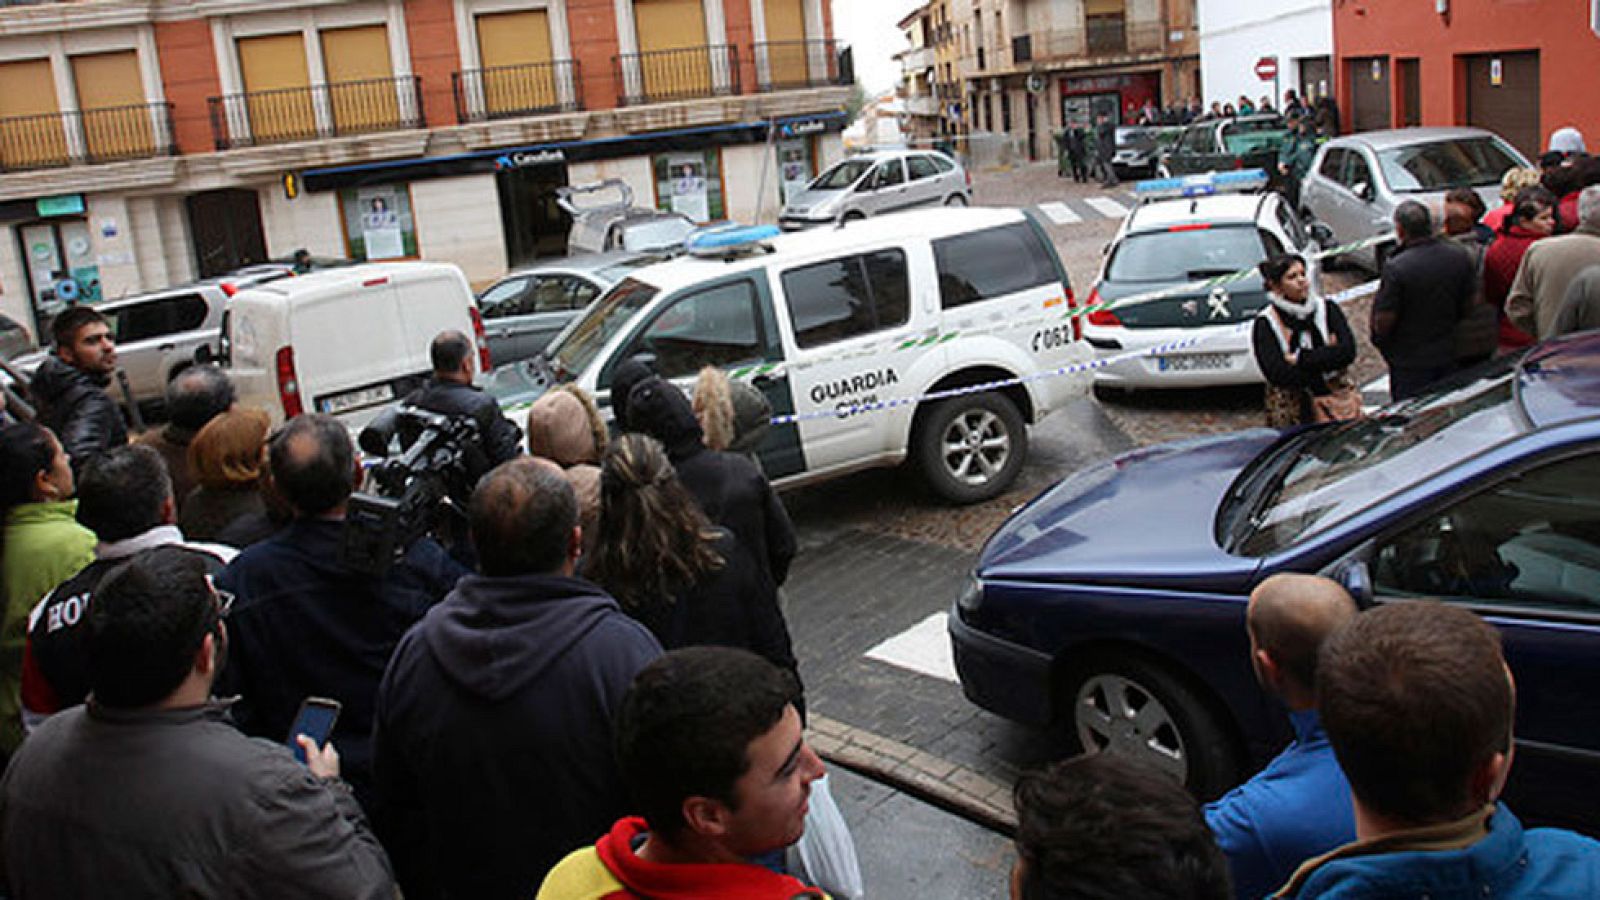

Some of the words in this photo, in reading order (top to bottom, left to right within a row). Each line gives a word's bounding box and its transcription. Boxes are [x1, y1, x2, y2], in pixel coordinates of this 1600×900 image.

[1042, 324, 1071, 350] 062
[810, 367, 899, 404] GUARDIA
[47, 592, 91, 633] HO
